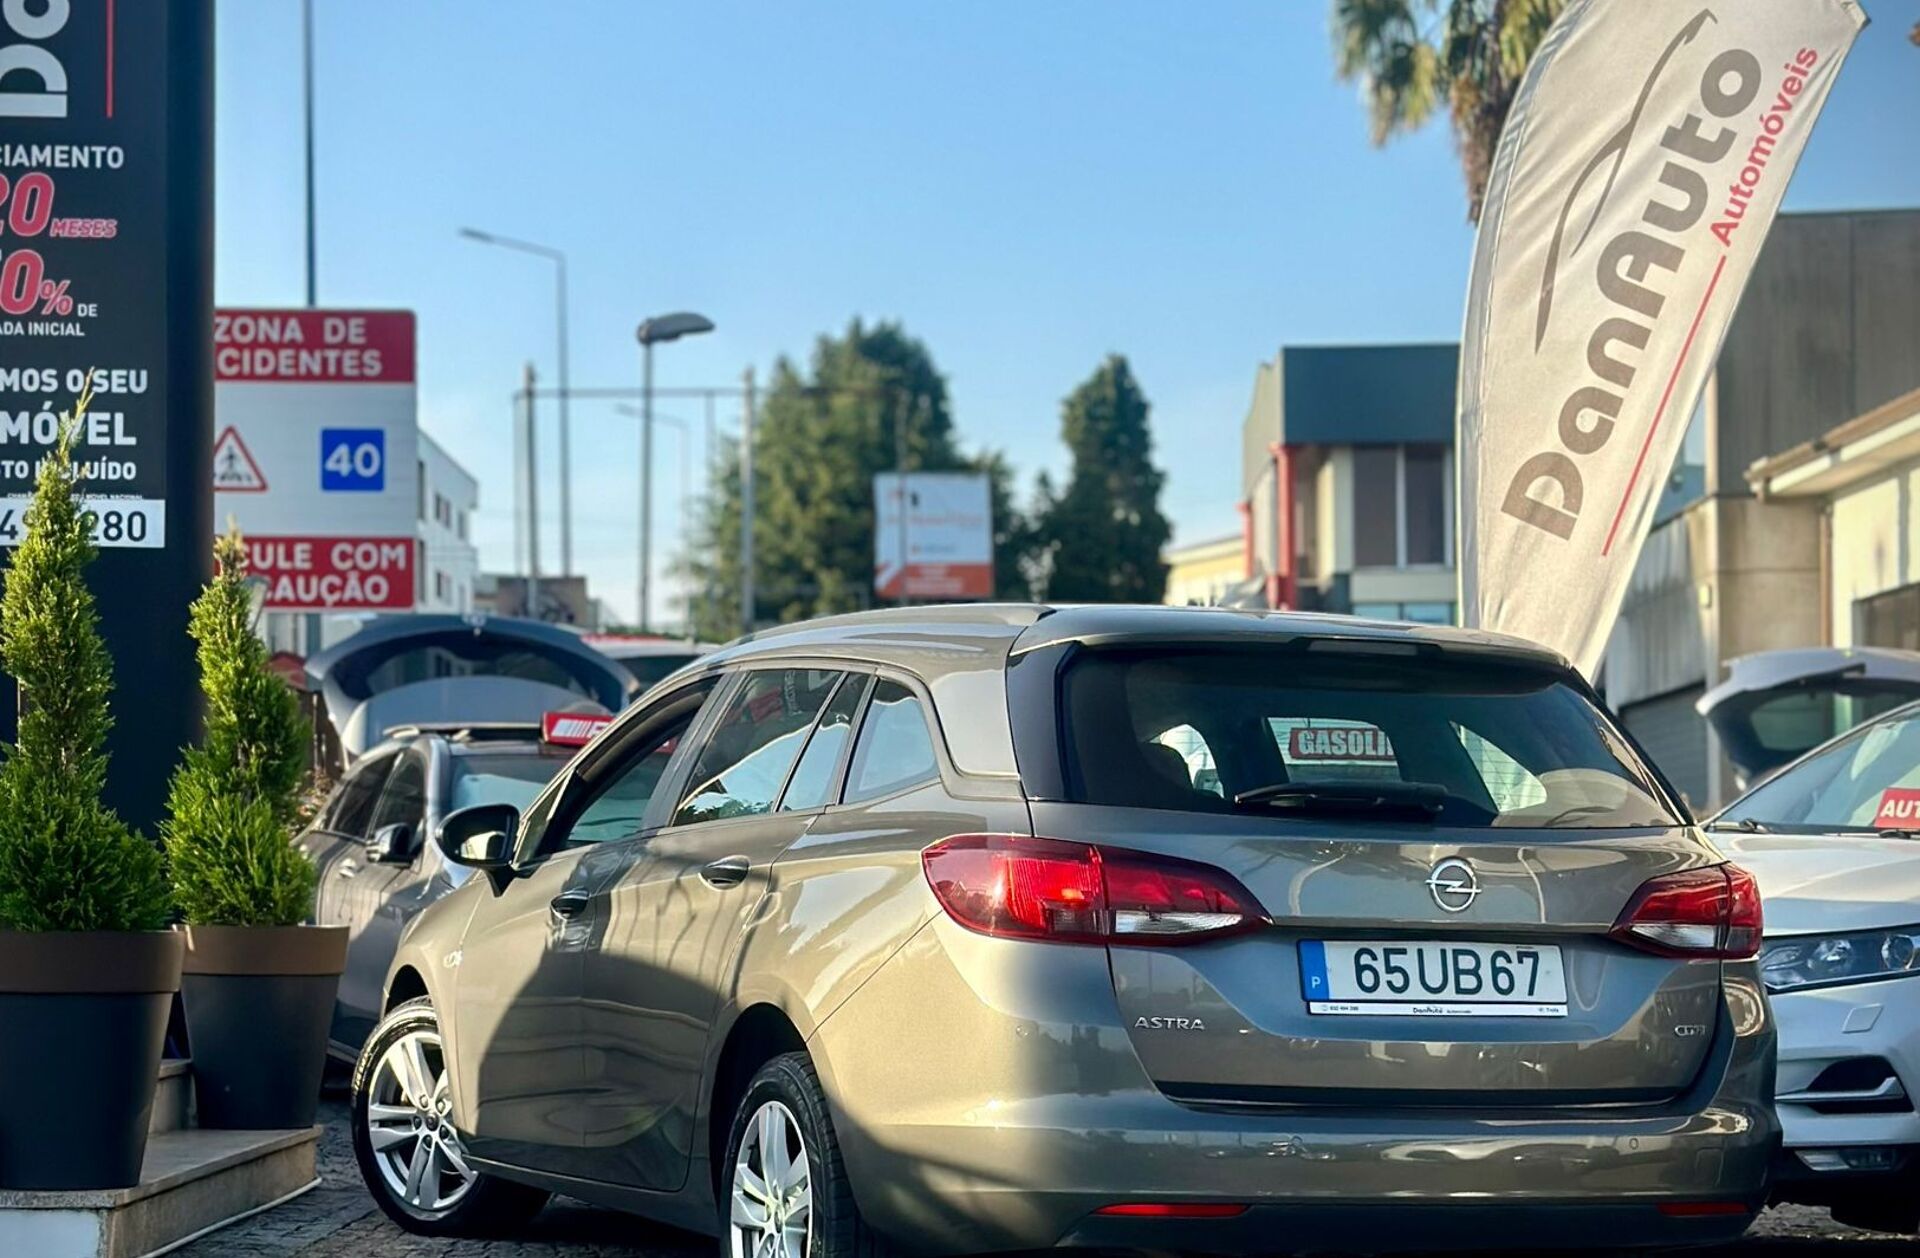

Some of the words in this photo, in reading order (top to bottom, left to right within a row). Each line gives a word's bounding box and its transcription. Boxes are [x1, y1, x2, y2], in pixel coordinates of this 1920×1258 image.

[0, 144, 124, 169] IAMENTO
[1710, 48, 1818, 247] Automóveis
[0, 172, 55, 237] 0
[50, 218, 118, 238] MESES
[1501, 48, 1762, 541] DanAuto
[77, 303, 98, 317] DE
[28, 321, 86, 337] INICIAL
[214, 315, 304, 344] ZONA
[323, 317, 367, 344] DE
[0, 367, 59, 393] MOS
[66, 368, 85, 393] O
[92, 369, 148, 394] SEU
[0, 460, 29, 479] TO
[35, 456, 138, 480] ILUÍDO
[324, 442, 382, 478] 40
[330, 542, 407, 571] COM
[267, 570, 389, 607] AUÇÃO
[1311, 976, 1321, 988] P
[1134, 1016, 1205, 1031] ASTRA
